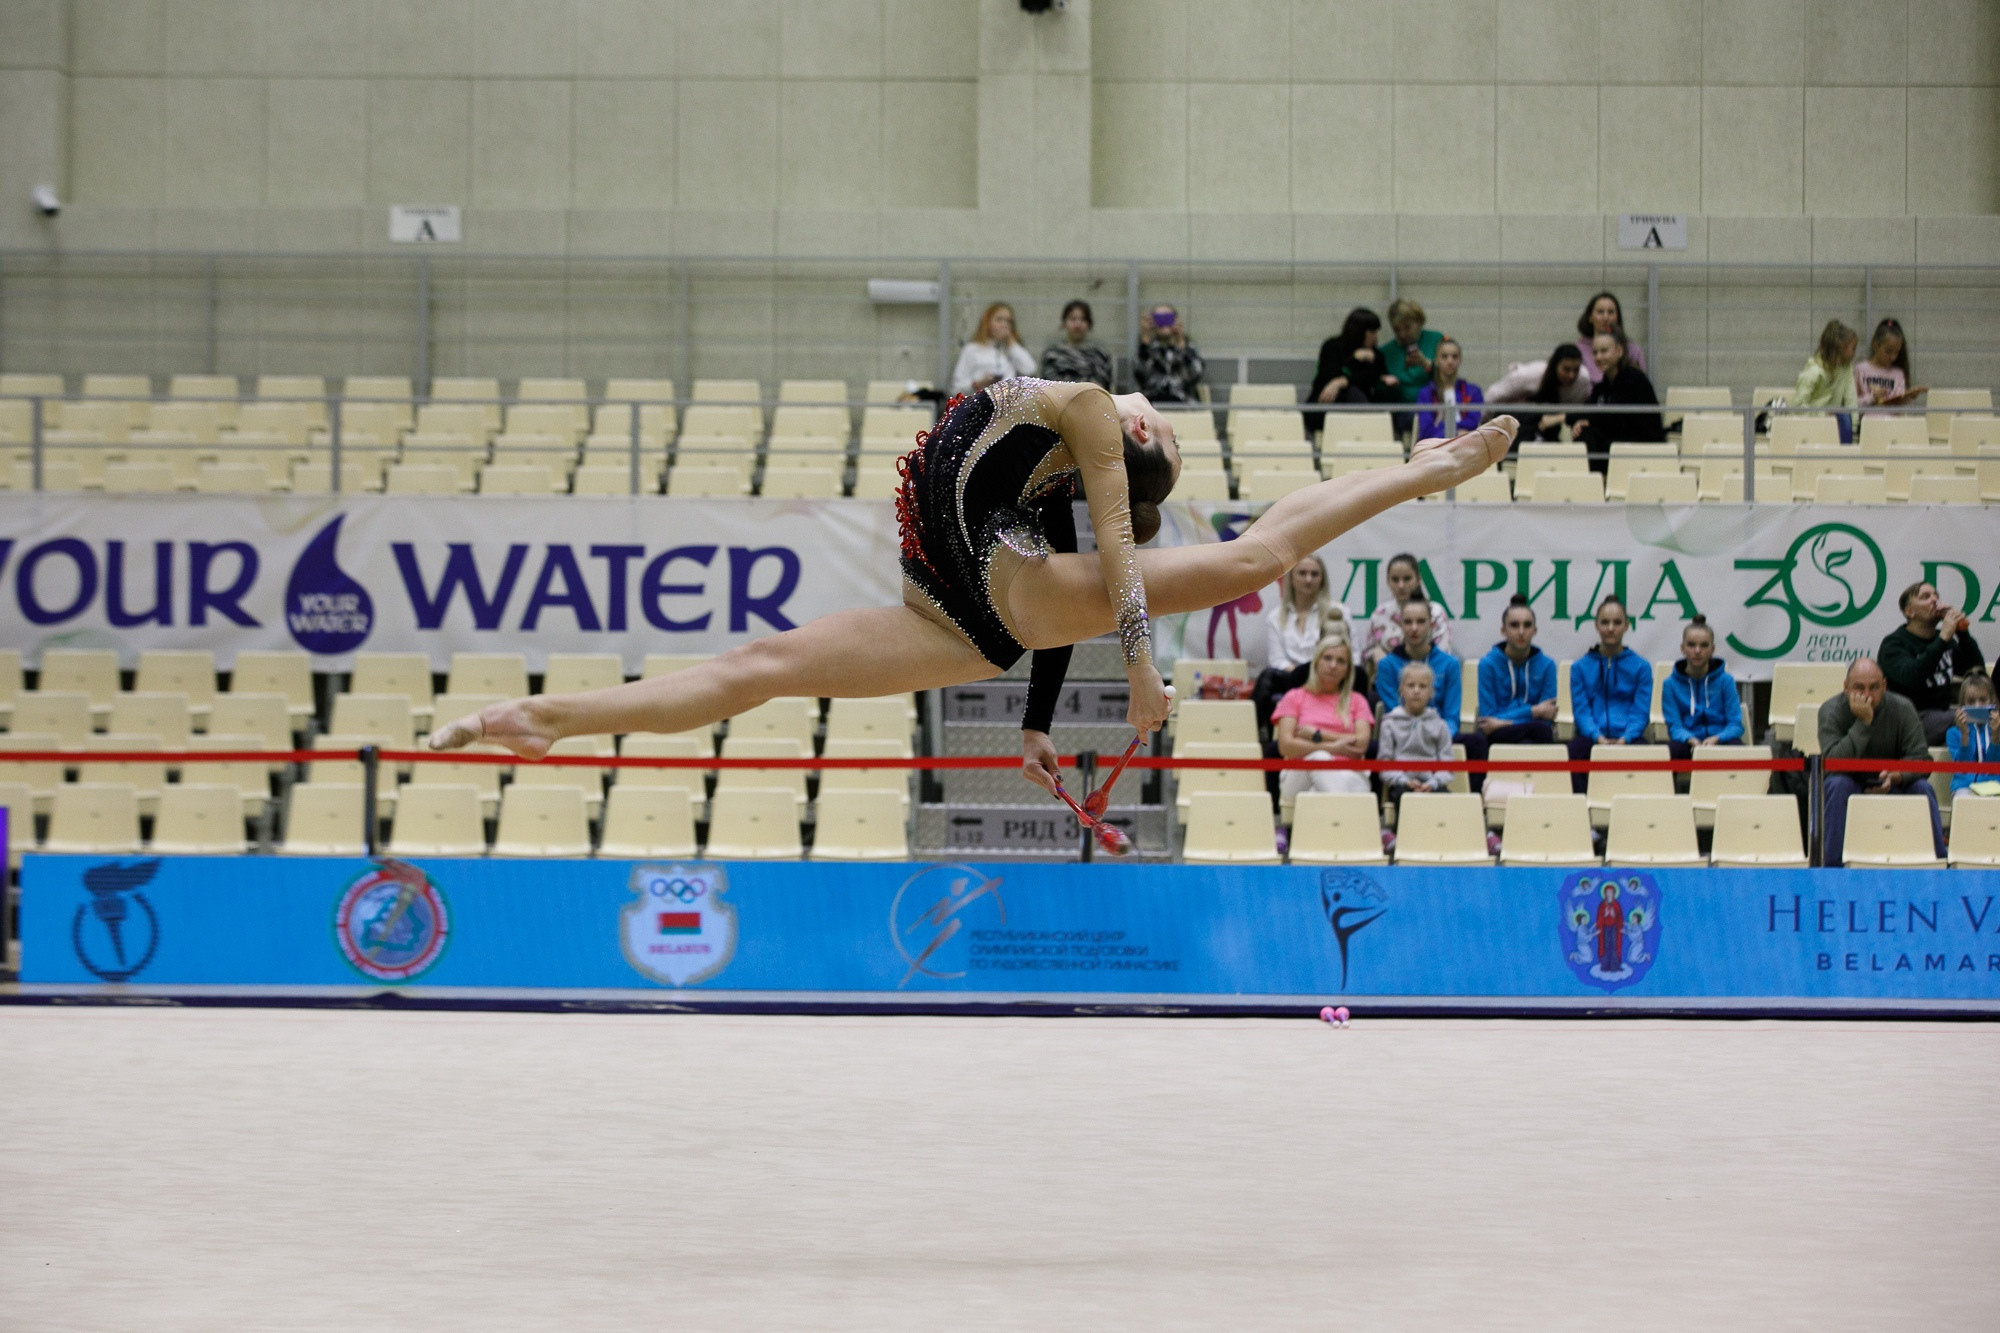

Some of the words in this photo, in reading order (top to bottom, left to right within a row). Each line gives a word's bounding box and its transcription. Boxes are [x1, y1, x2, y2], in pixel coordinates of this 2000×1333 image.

[1643, 226, 1664, 248] А
[390, 542, 802, 633] WATER
[1725, 522, 1887, 660] 30
[298, 593, 359, 612] YOUR
[289, 612, 369, 633] WATER
[1806, 634, 1847, 648] лет
[1064, 690, 1081, 714] 4
[1003, 819, 1056, 842] РЯД
[1064, 815, 1080, 840] 3
[1767, 894, 1939, 933] HELEN
[1961, 896, 2000, 933] V
[1817, 953, 2000, 972] BELAMAR
